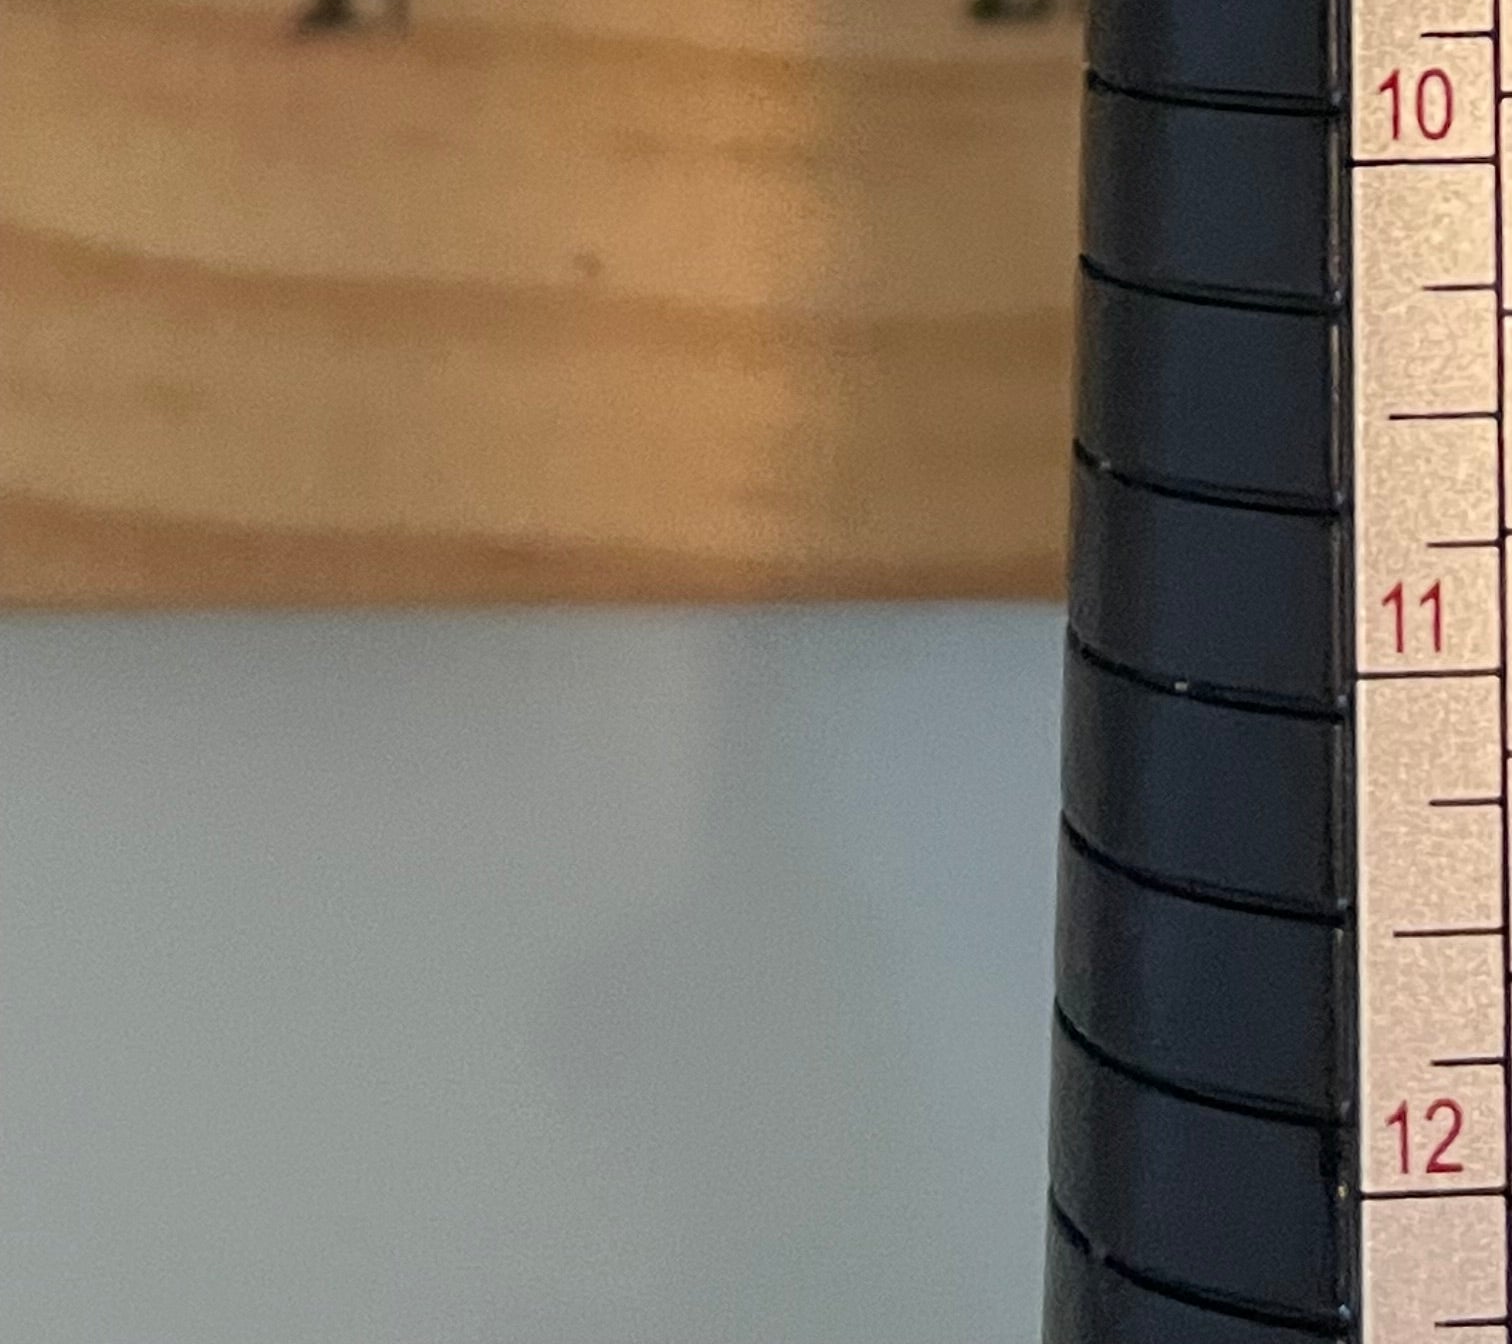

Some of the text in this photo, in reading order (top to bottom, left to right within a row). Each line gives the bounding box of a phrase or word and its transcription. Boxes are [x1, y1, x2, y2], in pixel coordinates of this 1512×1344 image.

[1378, 67, 1455, 142] 10
[1382, 581, 1444, 653] 11
[1389, 1098, 1464, 1175] 12
